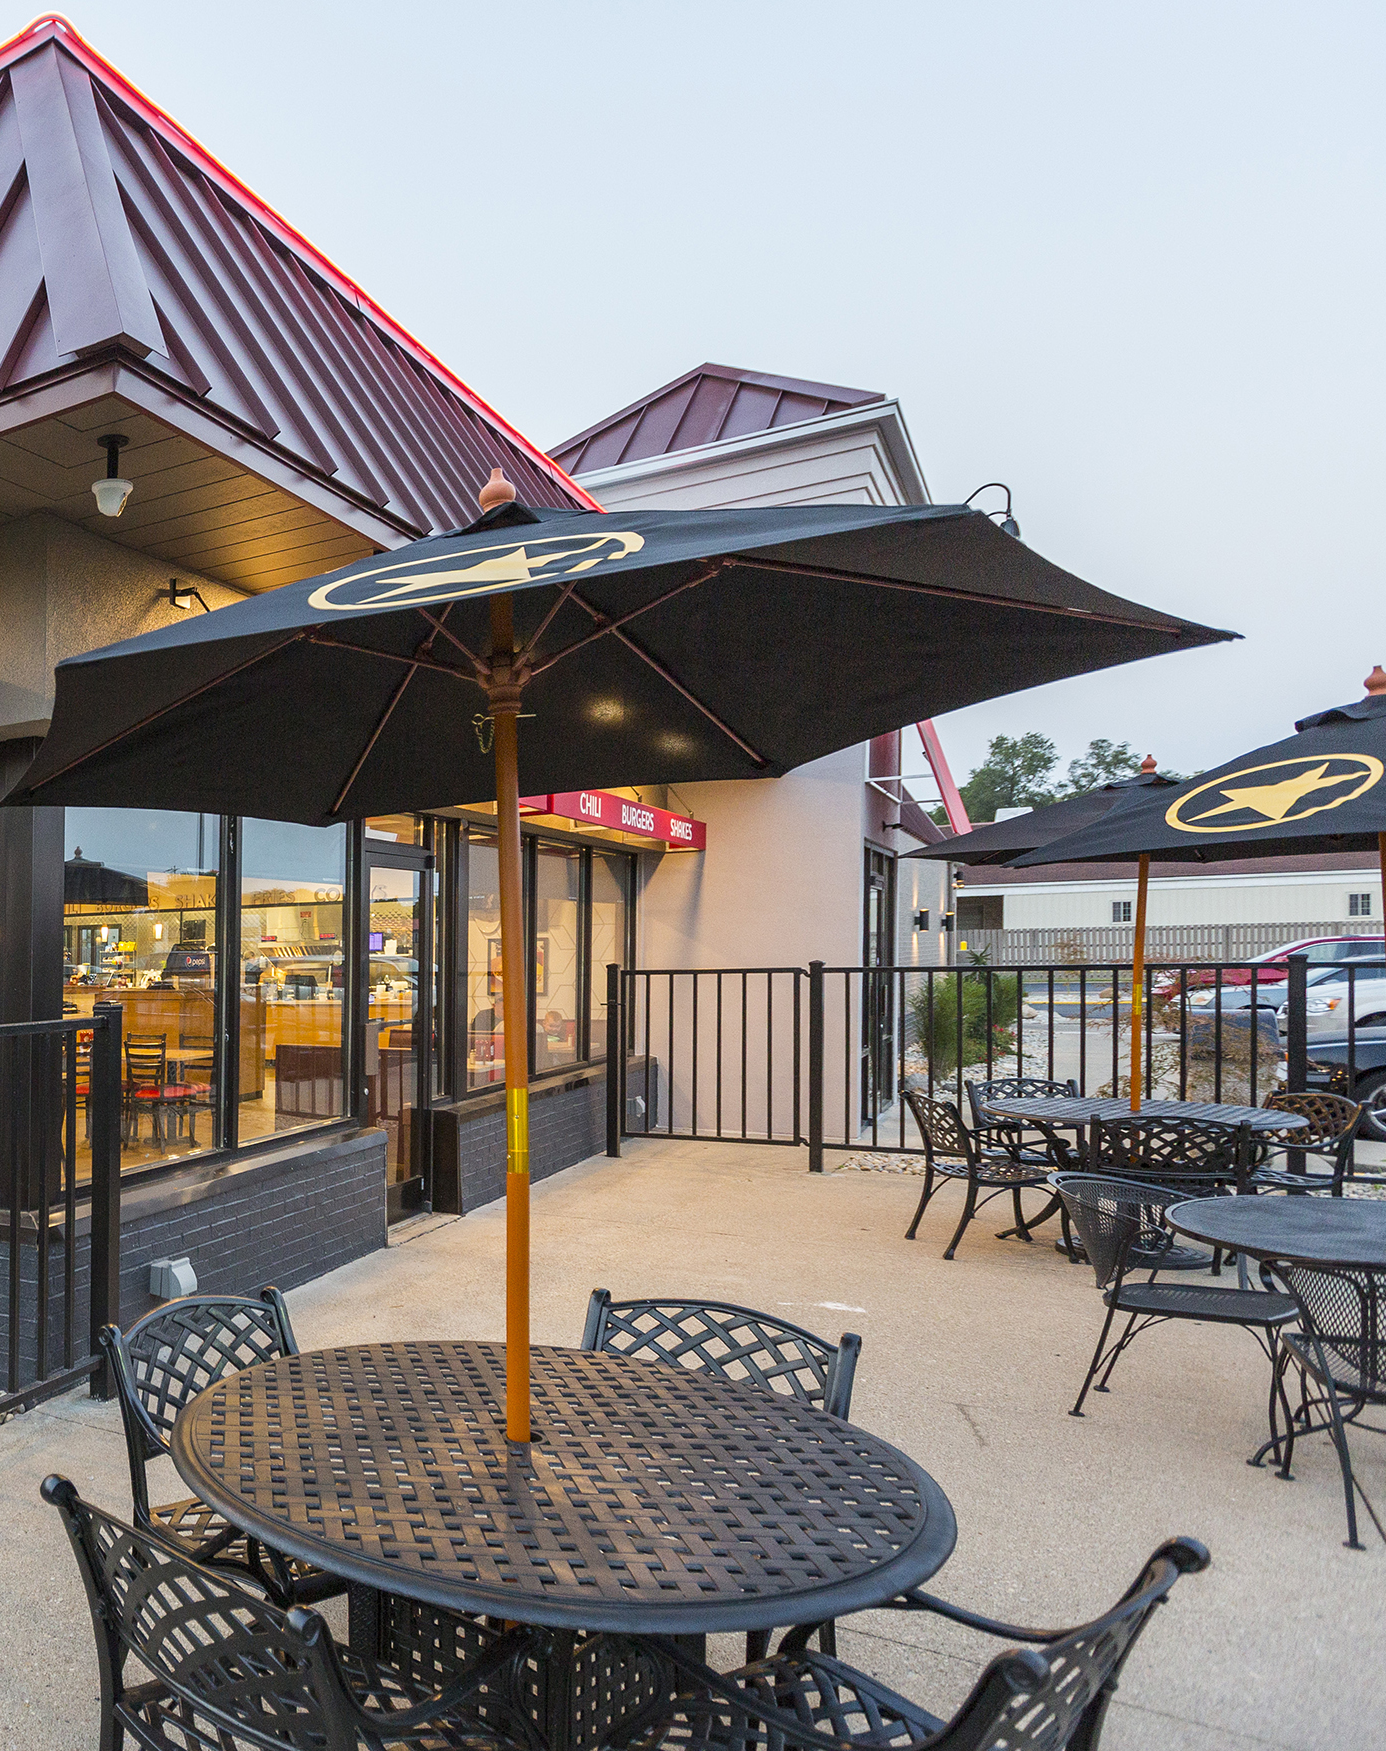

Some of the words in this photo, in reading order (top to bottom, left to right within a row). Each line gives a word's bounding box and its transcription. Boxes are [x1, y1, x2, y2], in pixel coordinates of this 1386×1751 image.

[579, 792, 602, 818] CHILI
[621, 804, 654, 832] BURGERS
[670, 818, 693, 841] SHAKES
[175, 893, 216, 908] SHAK
[252, 889, 296, 904] FRIES
[191, 957, 206, 966] pepsi
